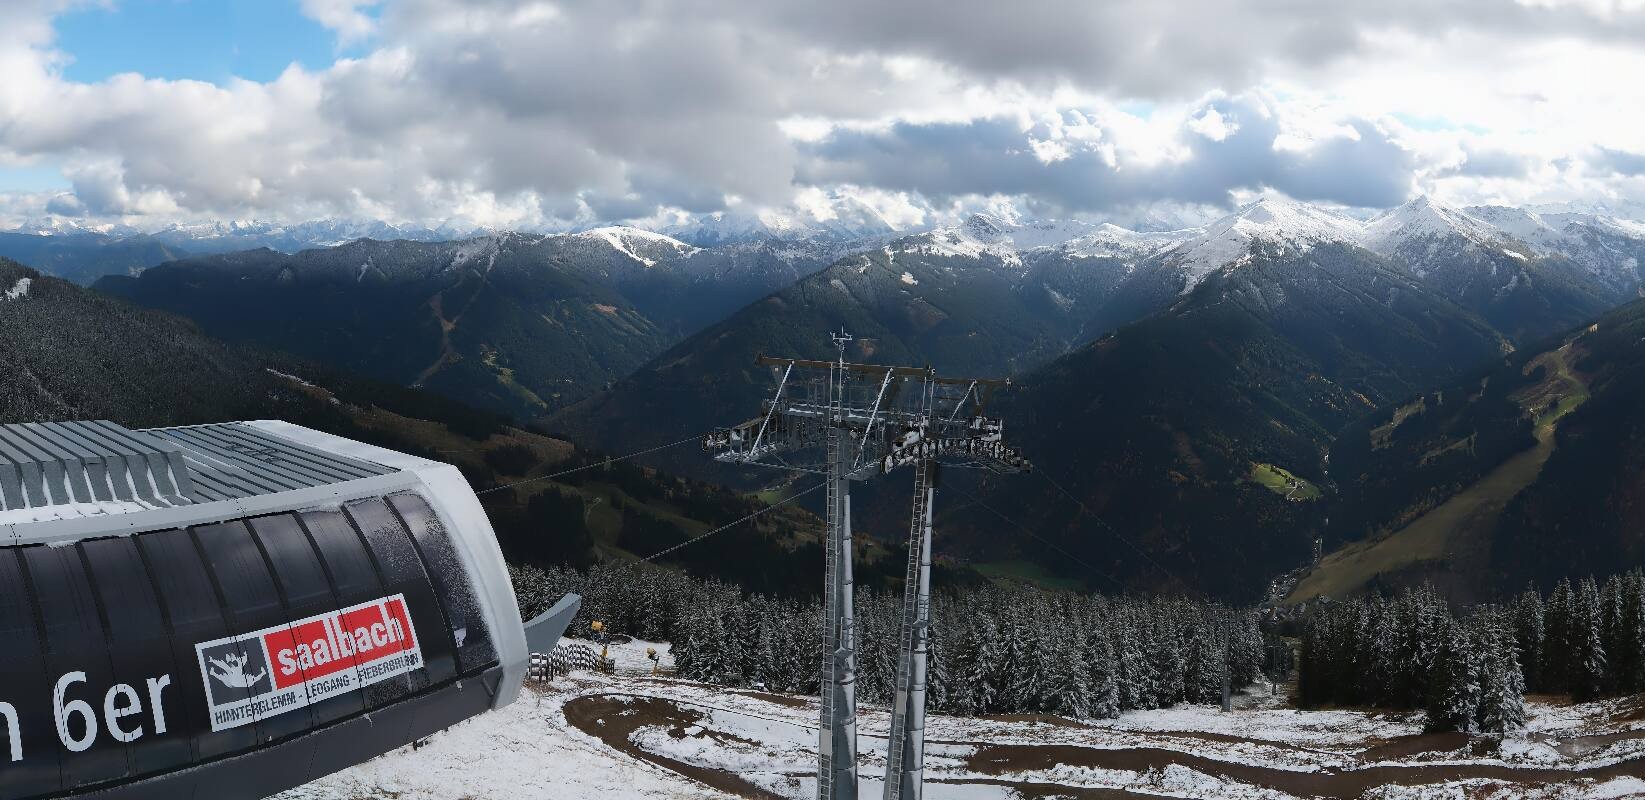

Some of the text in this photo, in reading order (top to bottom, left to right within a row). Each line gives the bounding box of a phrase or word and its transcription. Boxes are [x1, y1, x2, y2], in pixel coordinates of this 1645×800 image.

[277, 600, 405, 676] saalbach
[53, 671, 171, 752] 6er
[215, 690, 297, 725] HINTERGLEMM
[306, 673, 351, 699] LEOGANG
